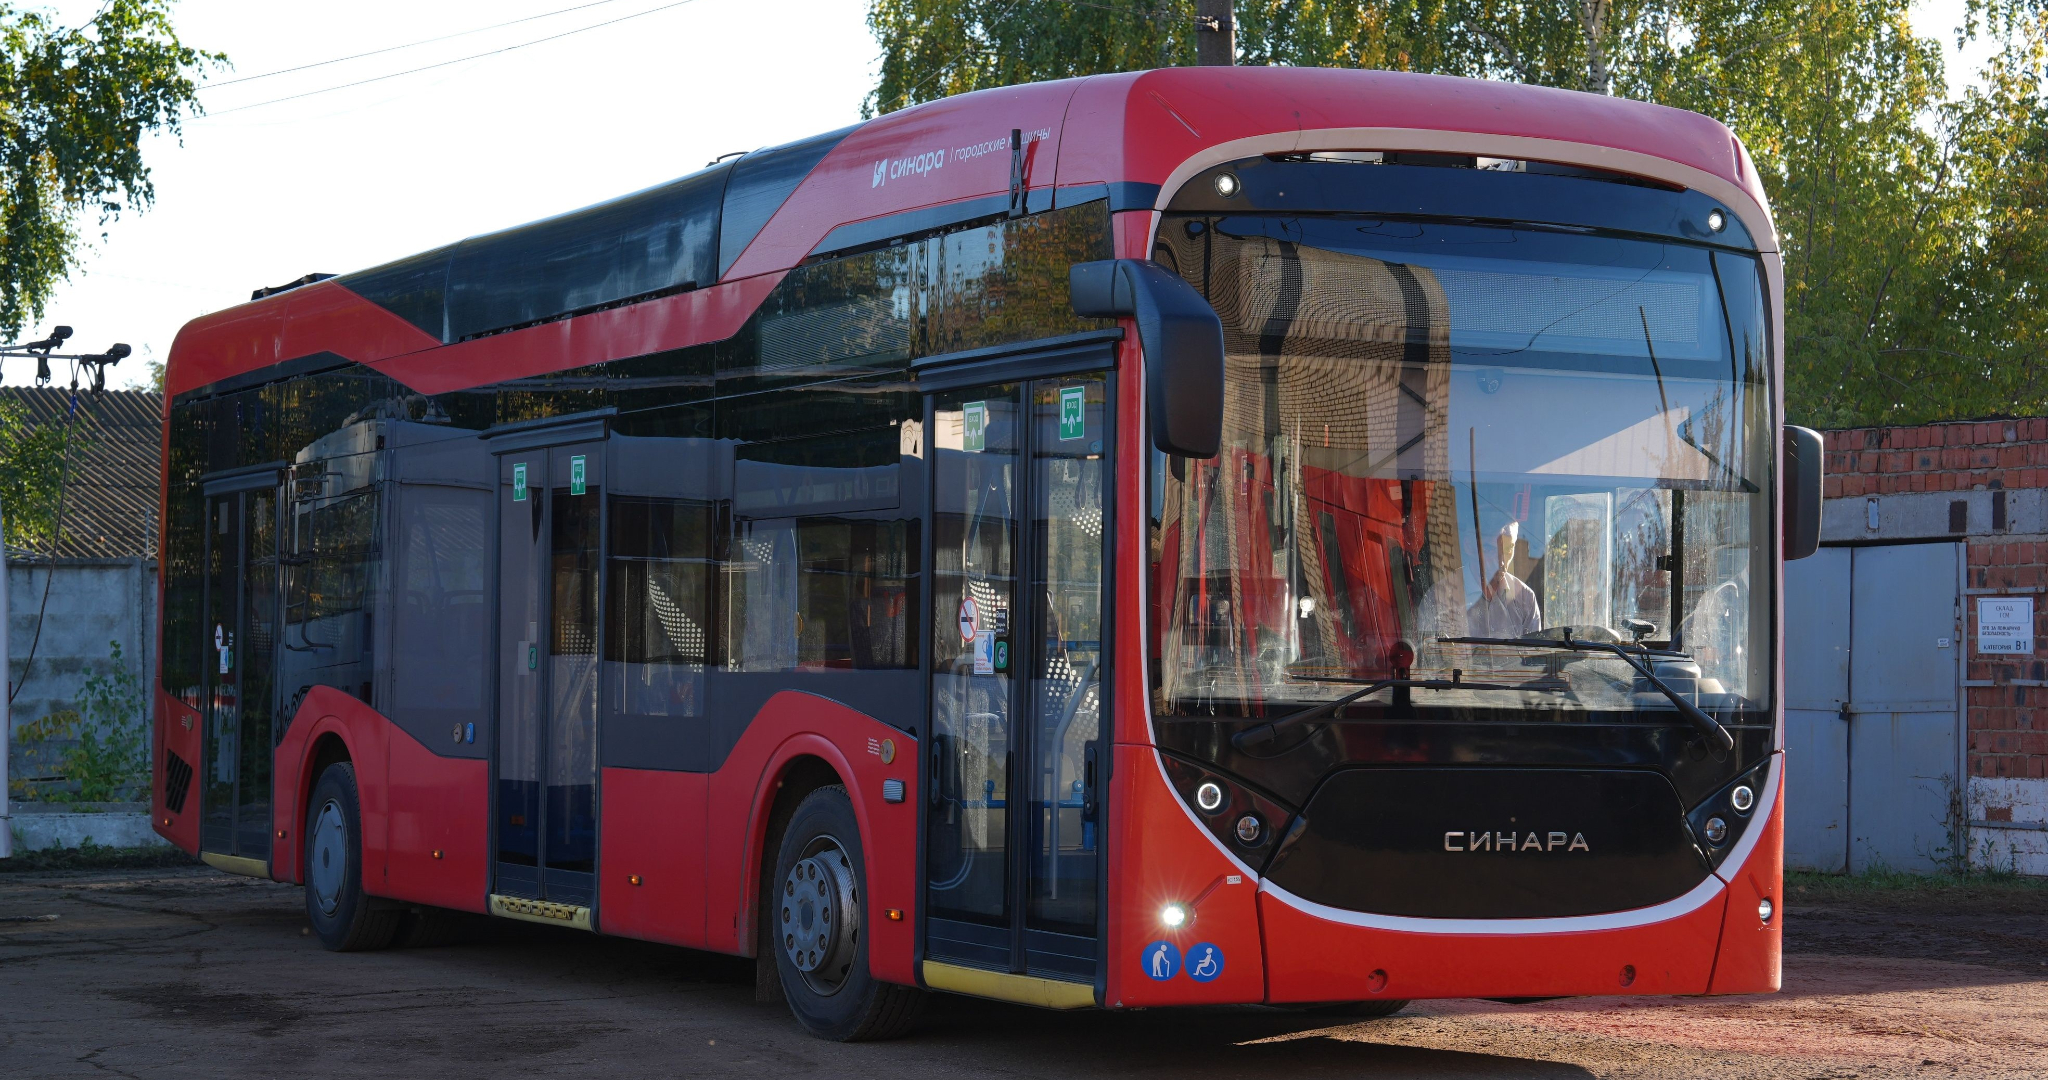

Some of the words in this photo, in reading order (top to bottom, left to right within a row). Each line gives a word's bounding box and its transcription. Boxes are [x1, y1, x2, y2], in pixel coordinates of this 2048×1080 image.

[890, 149, 945, 179] синара
[954, 137, 1006, 163] городские
[1444, 831, 1590, 852] СИНАРА
